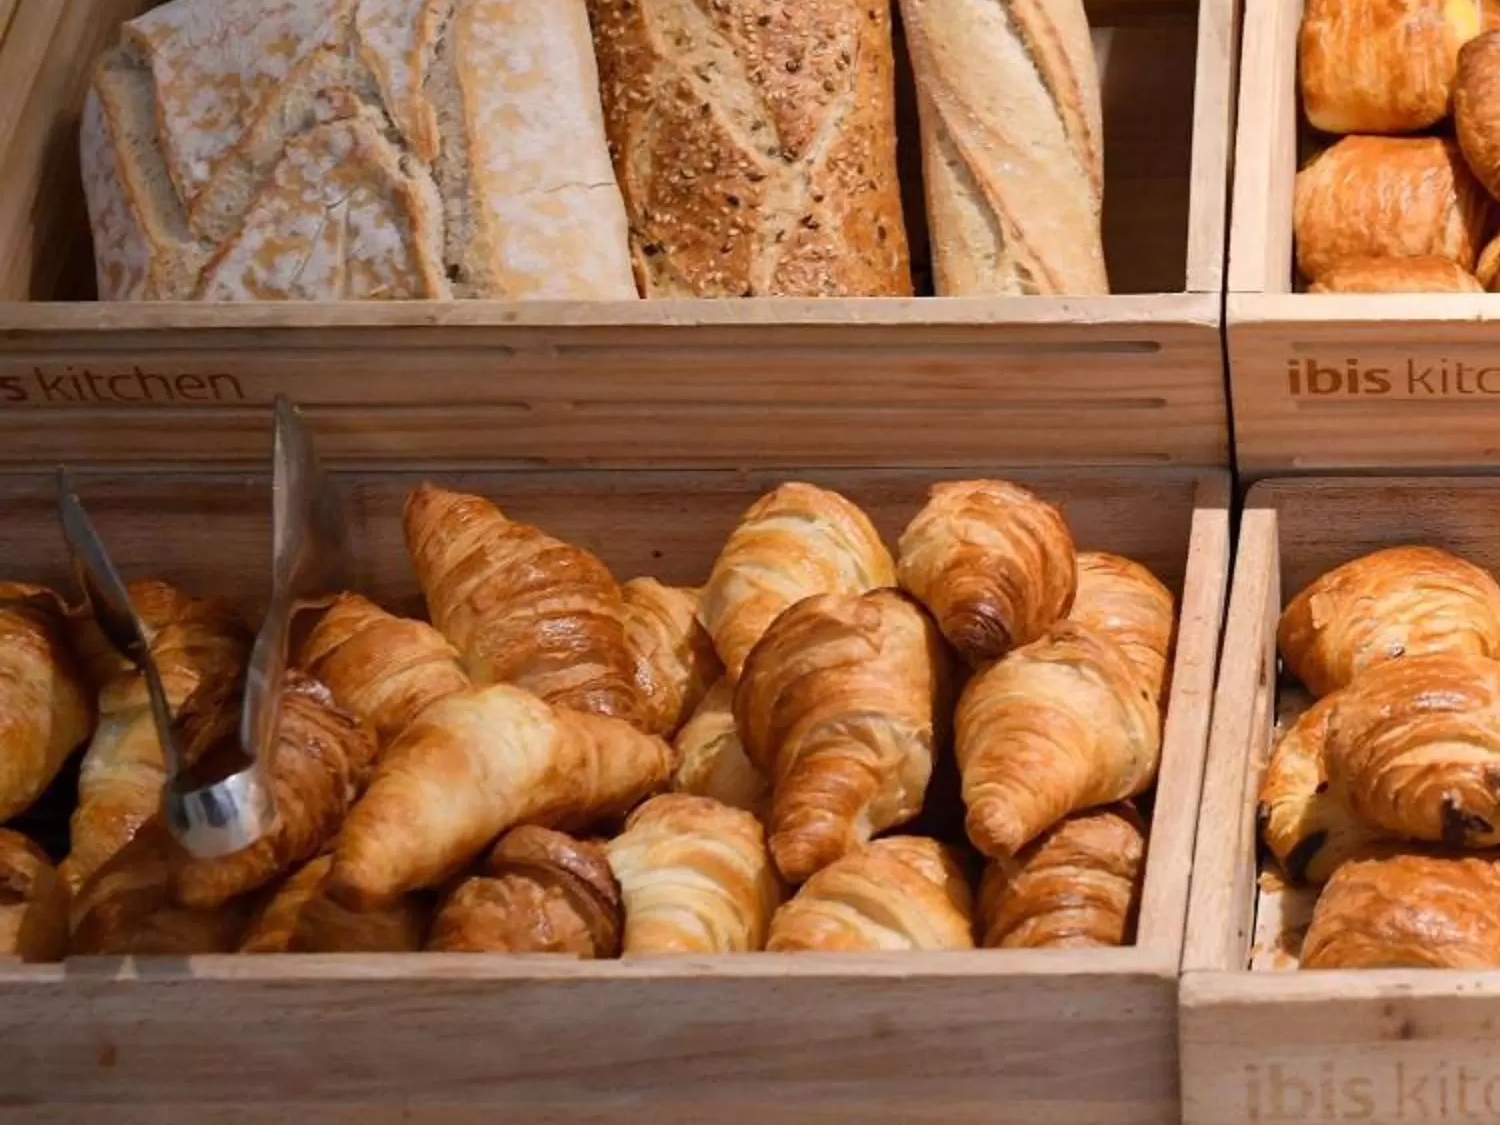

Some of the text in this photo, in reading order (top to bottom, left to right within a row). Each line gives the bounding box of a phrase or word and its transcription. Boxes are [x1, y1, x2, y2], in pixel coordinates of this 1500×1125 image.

[33, 366, 244, 401] kitchen
[1288, 359, 1391, 395] ibis
[1244, 1061, 1376, 1122] ibis
